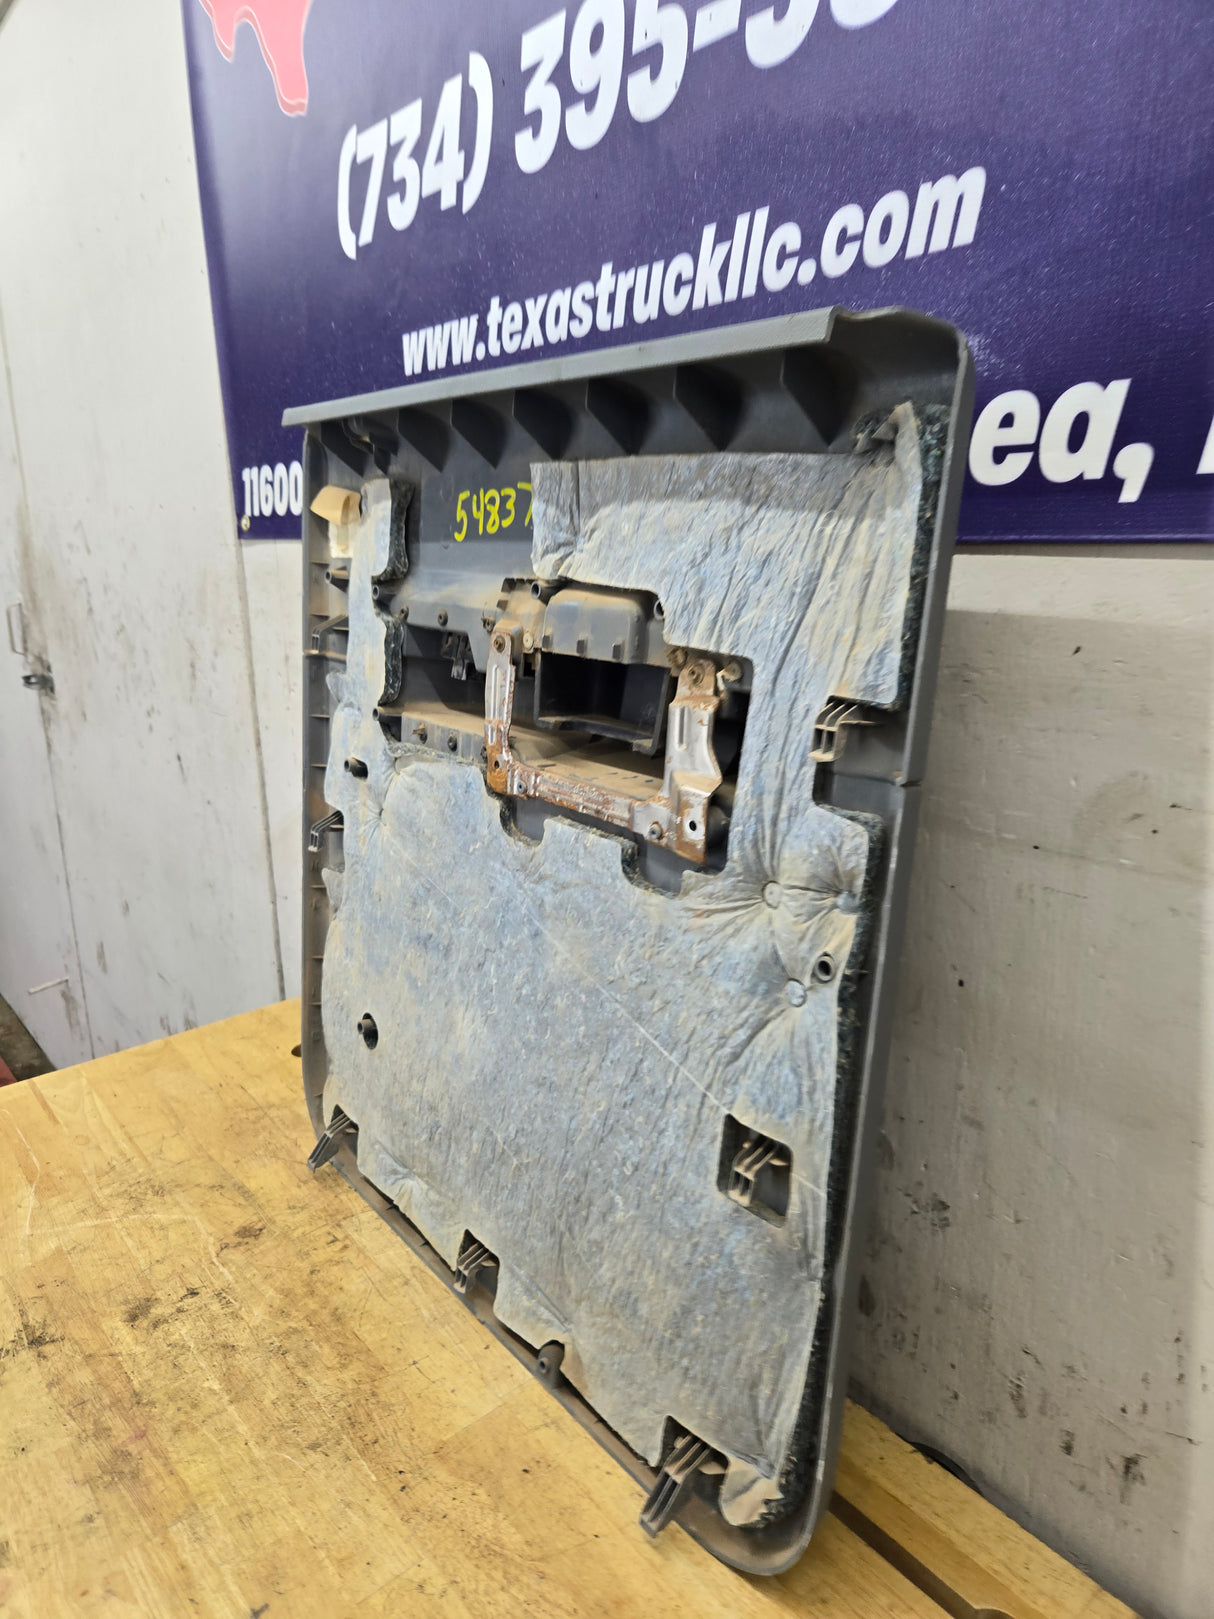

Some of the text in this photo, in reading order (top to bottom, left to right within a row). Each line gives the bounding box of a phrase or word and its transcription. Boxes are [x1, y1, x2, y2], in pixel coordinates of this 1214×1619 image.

[337, 51, 494, 260] (734)
[401, 166, 987, 377] www.texastruckllc.com
[241, 461, 304, 518] 11600
